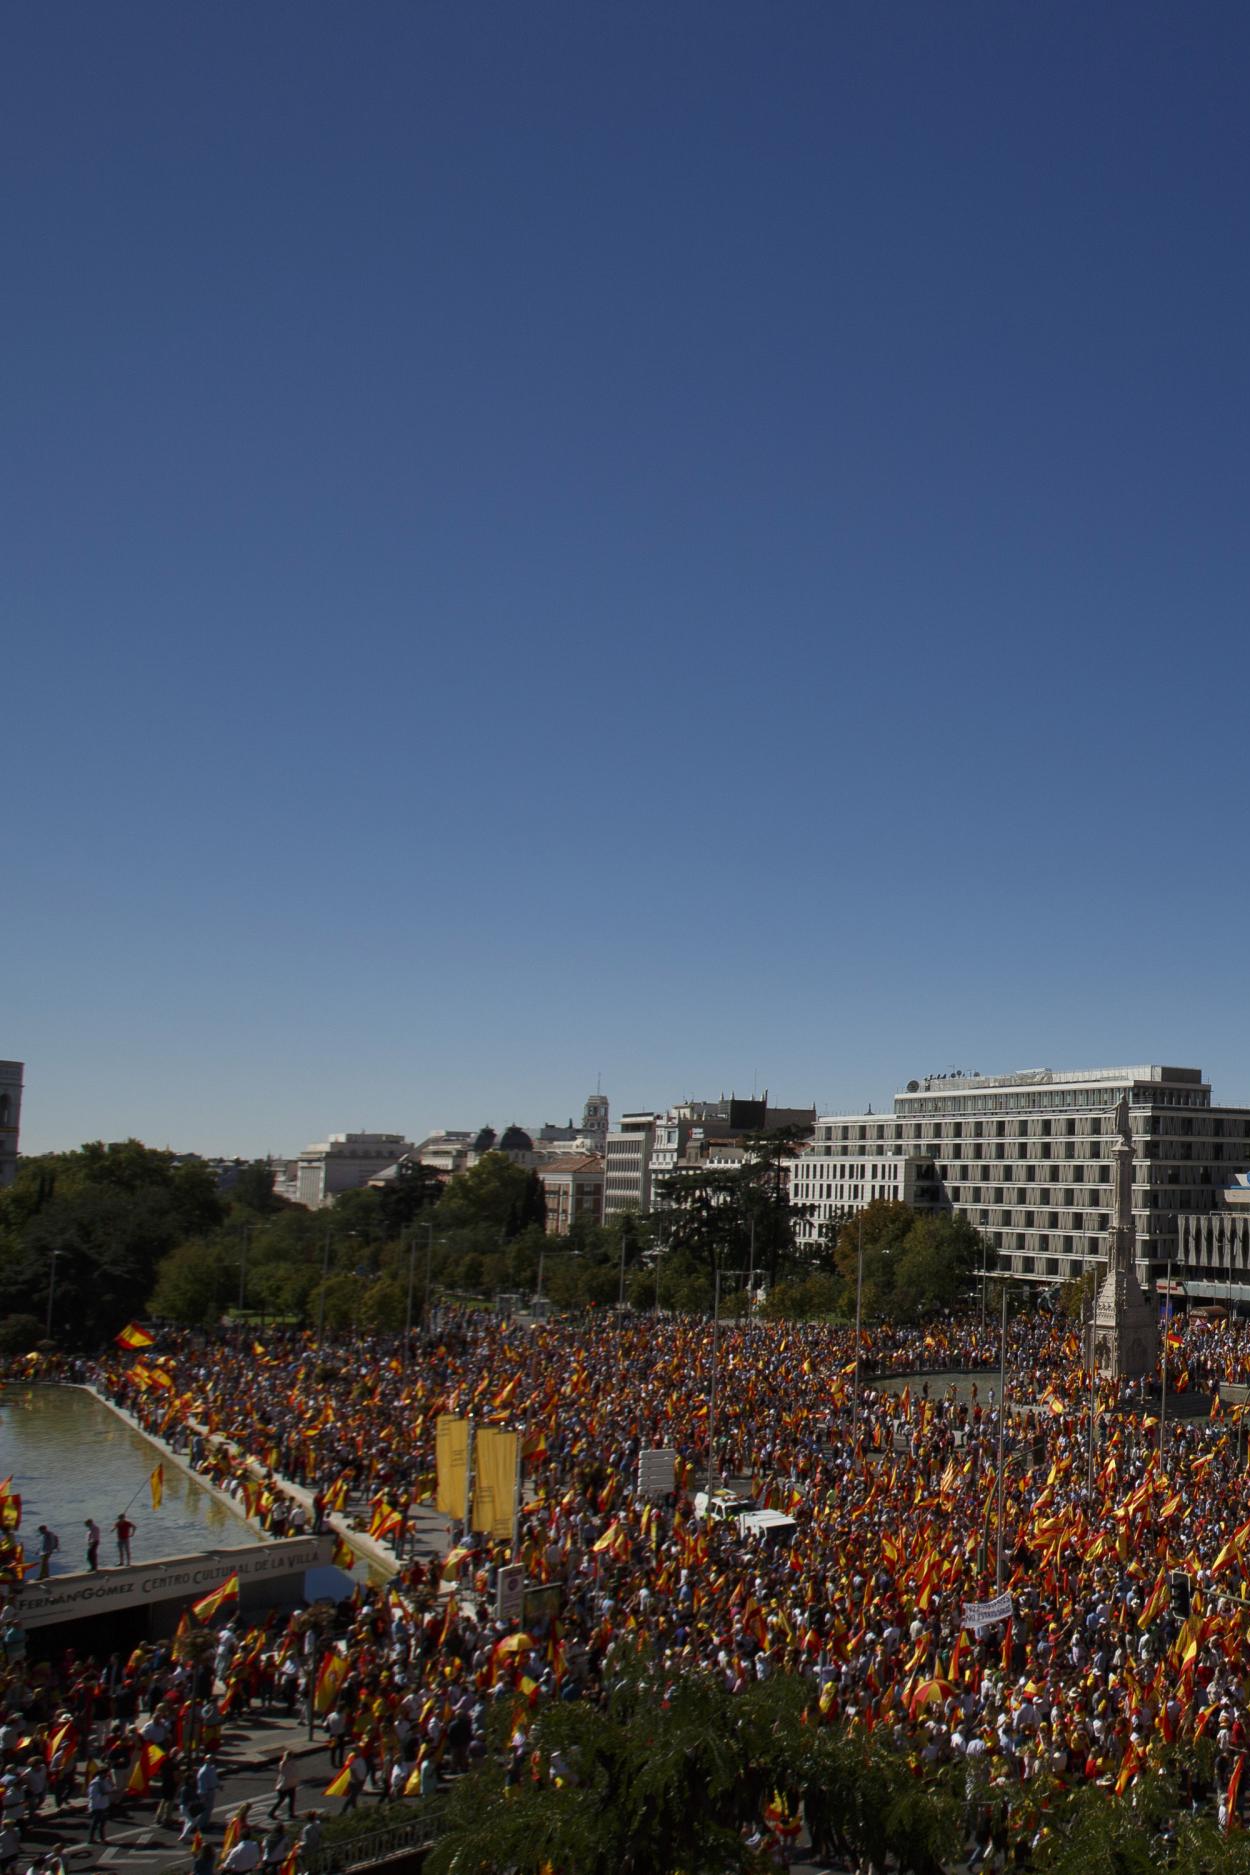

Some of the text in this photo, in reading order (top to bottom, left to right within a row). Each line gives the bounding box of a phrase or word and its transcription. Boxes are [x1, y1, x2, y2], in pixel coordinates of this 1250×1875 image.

[142, 1572, 190, 1593] CENTRO
[193, 1562, 251, 1585] CULTURAL
[256, 1559, 267, 1572] DE
[270, 1557, 284, 1569] LA
[288, 1551, 319, 1568] VILLA
